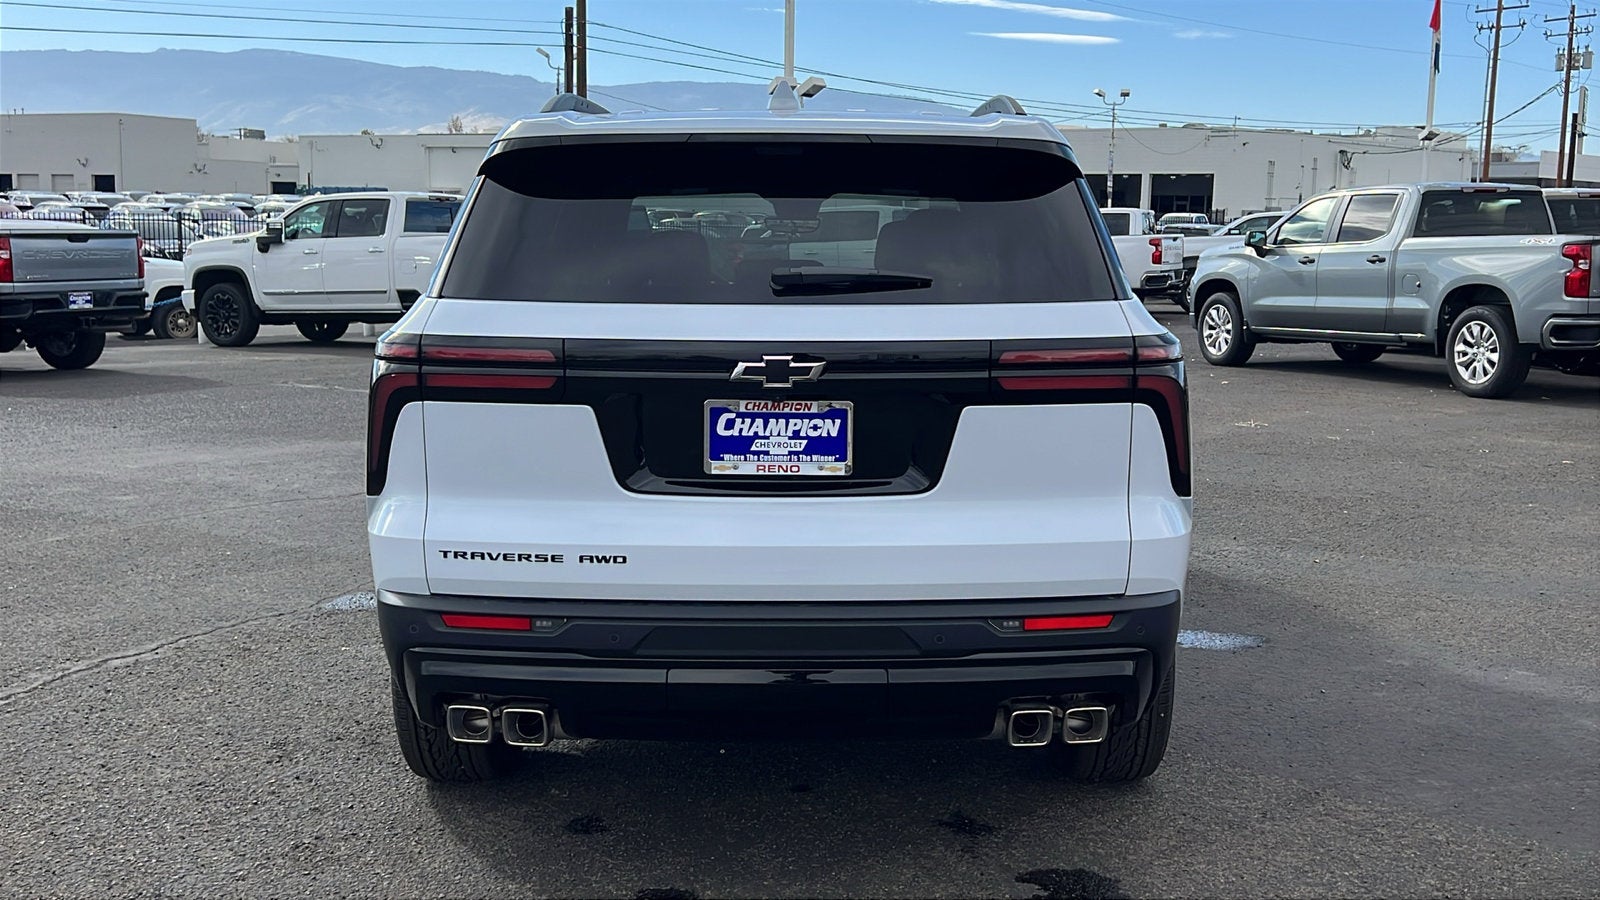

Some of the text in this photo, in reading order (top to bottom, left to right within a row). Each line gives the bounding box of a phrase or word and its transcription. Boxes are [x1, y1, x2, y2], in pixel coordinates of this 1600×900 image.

[744, 401, 813, 412] CHAMPION
[754, 441, 803, 449] CHEVROLET
[746, 454, 758, 462] The
[758, 454, 791, 462] Customer
[799, 454, 812, 462] The
[756, 464, 801, 473] RENO
[438, 550, 628, 564] TRAVERSE AWD
